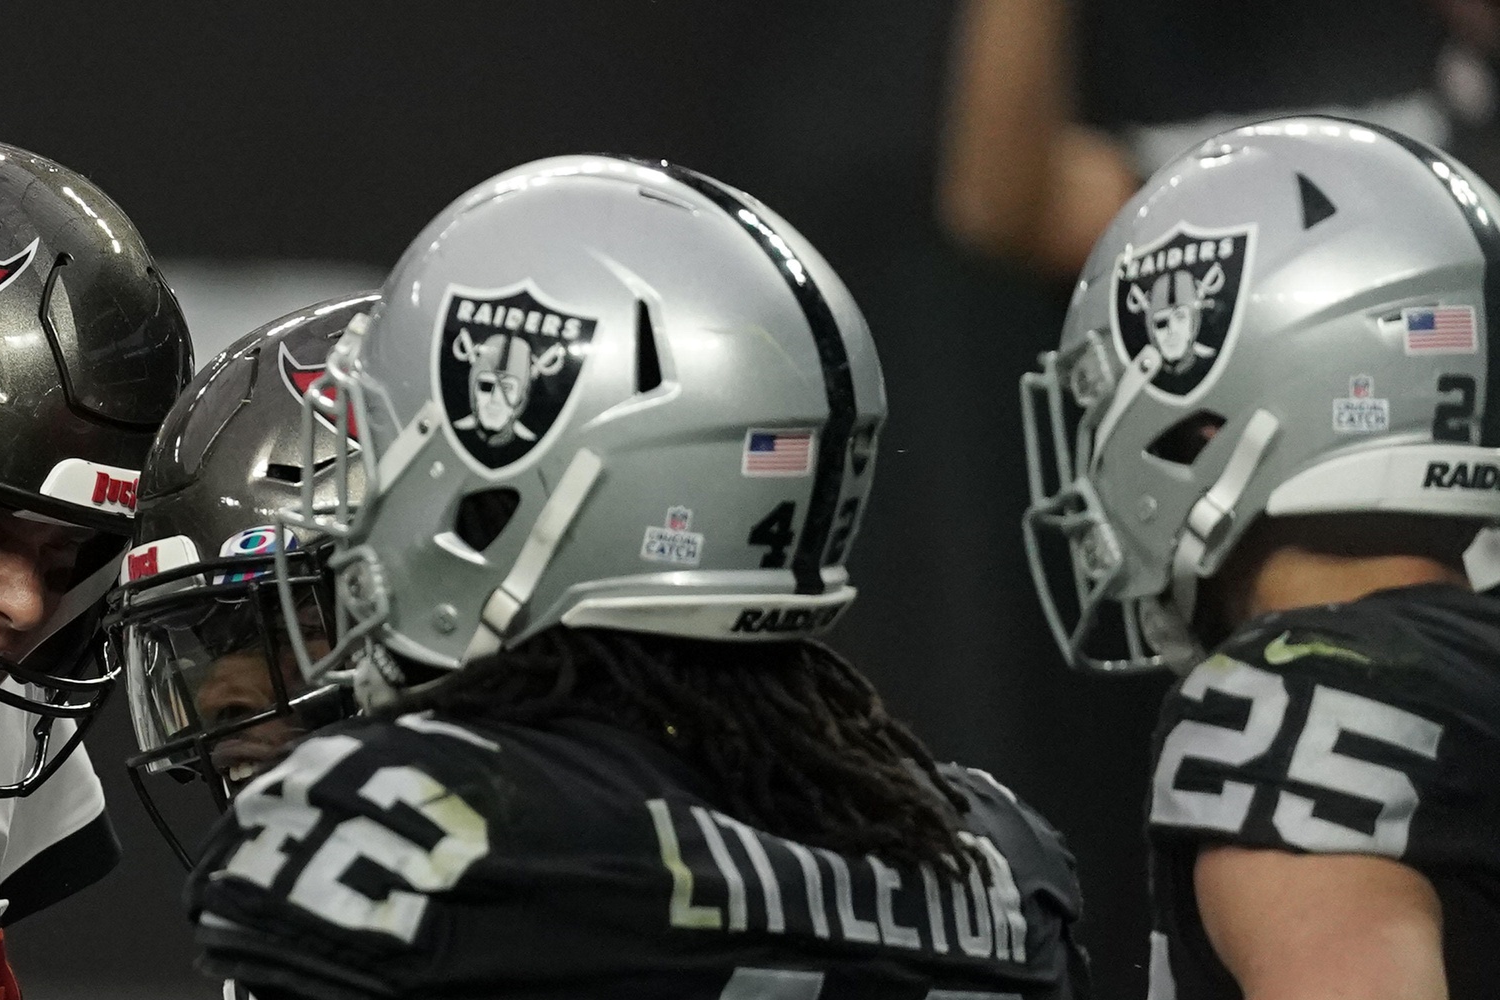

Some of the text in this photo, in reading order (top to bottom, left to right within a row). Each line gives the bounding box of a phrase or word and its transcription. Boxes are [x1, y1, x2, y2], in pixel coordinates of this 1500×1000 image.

[456, 299, 582, 340] RAIDERS
[1432, 373, 1476, 442] 2
[1422, 461, 1500, 490] RAID
[1150, 660, 1443, 860] 25
[209, 734, 490, 944] 42
